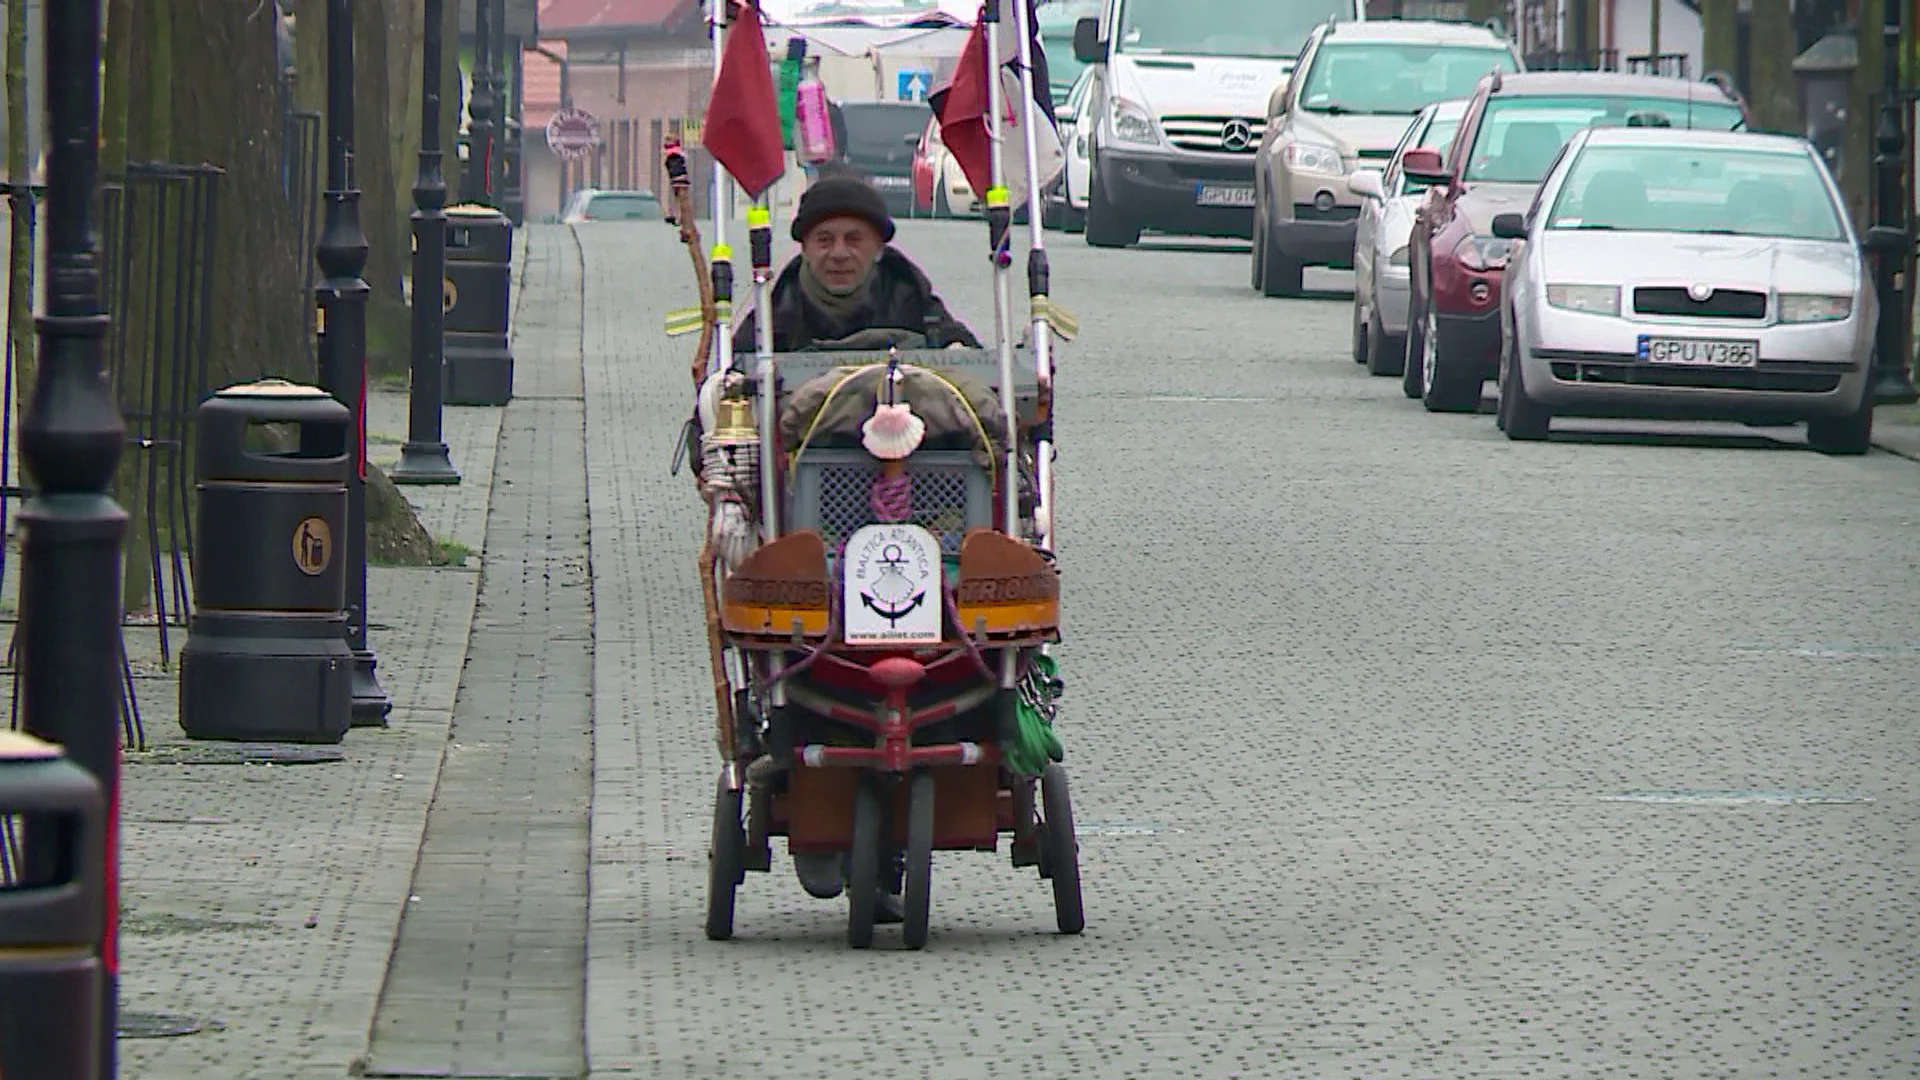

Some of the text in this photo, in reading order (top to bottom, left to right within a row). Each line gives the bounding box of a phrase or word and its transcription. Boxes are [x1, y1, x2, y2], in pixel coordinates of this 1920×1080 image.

[1653, 342, 1753, 365] GPU V385
[856, 528, 929, 580] BALTICA ATLANTICA
